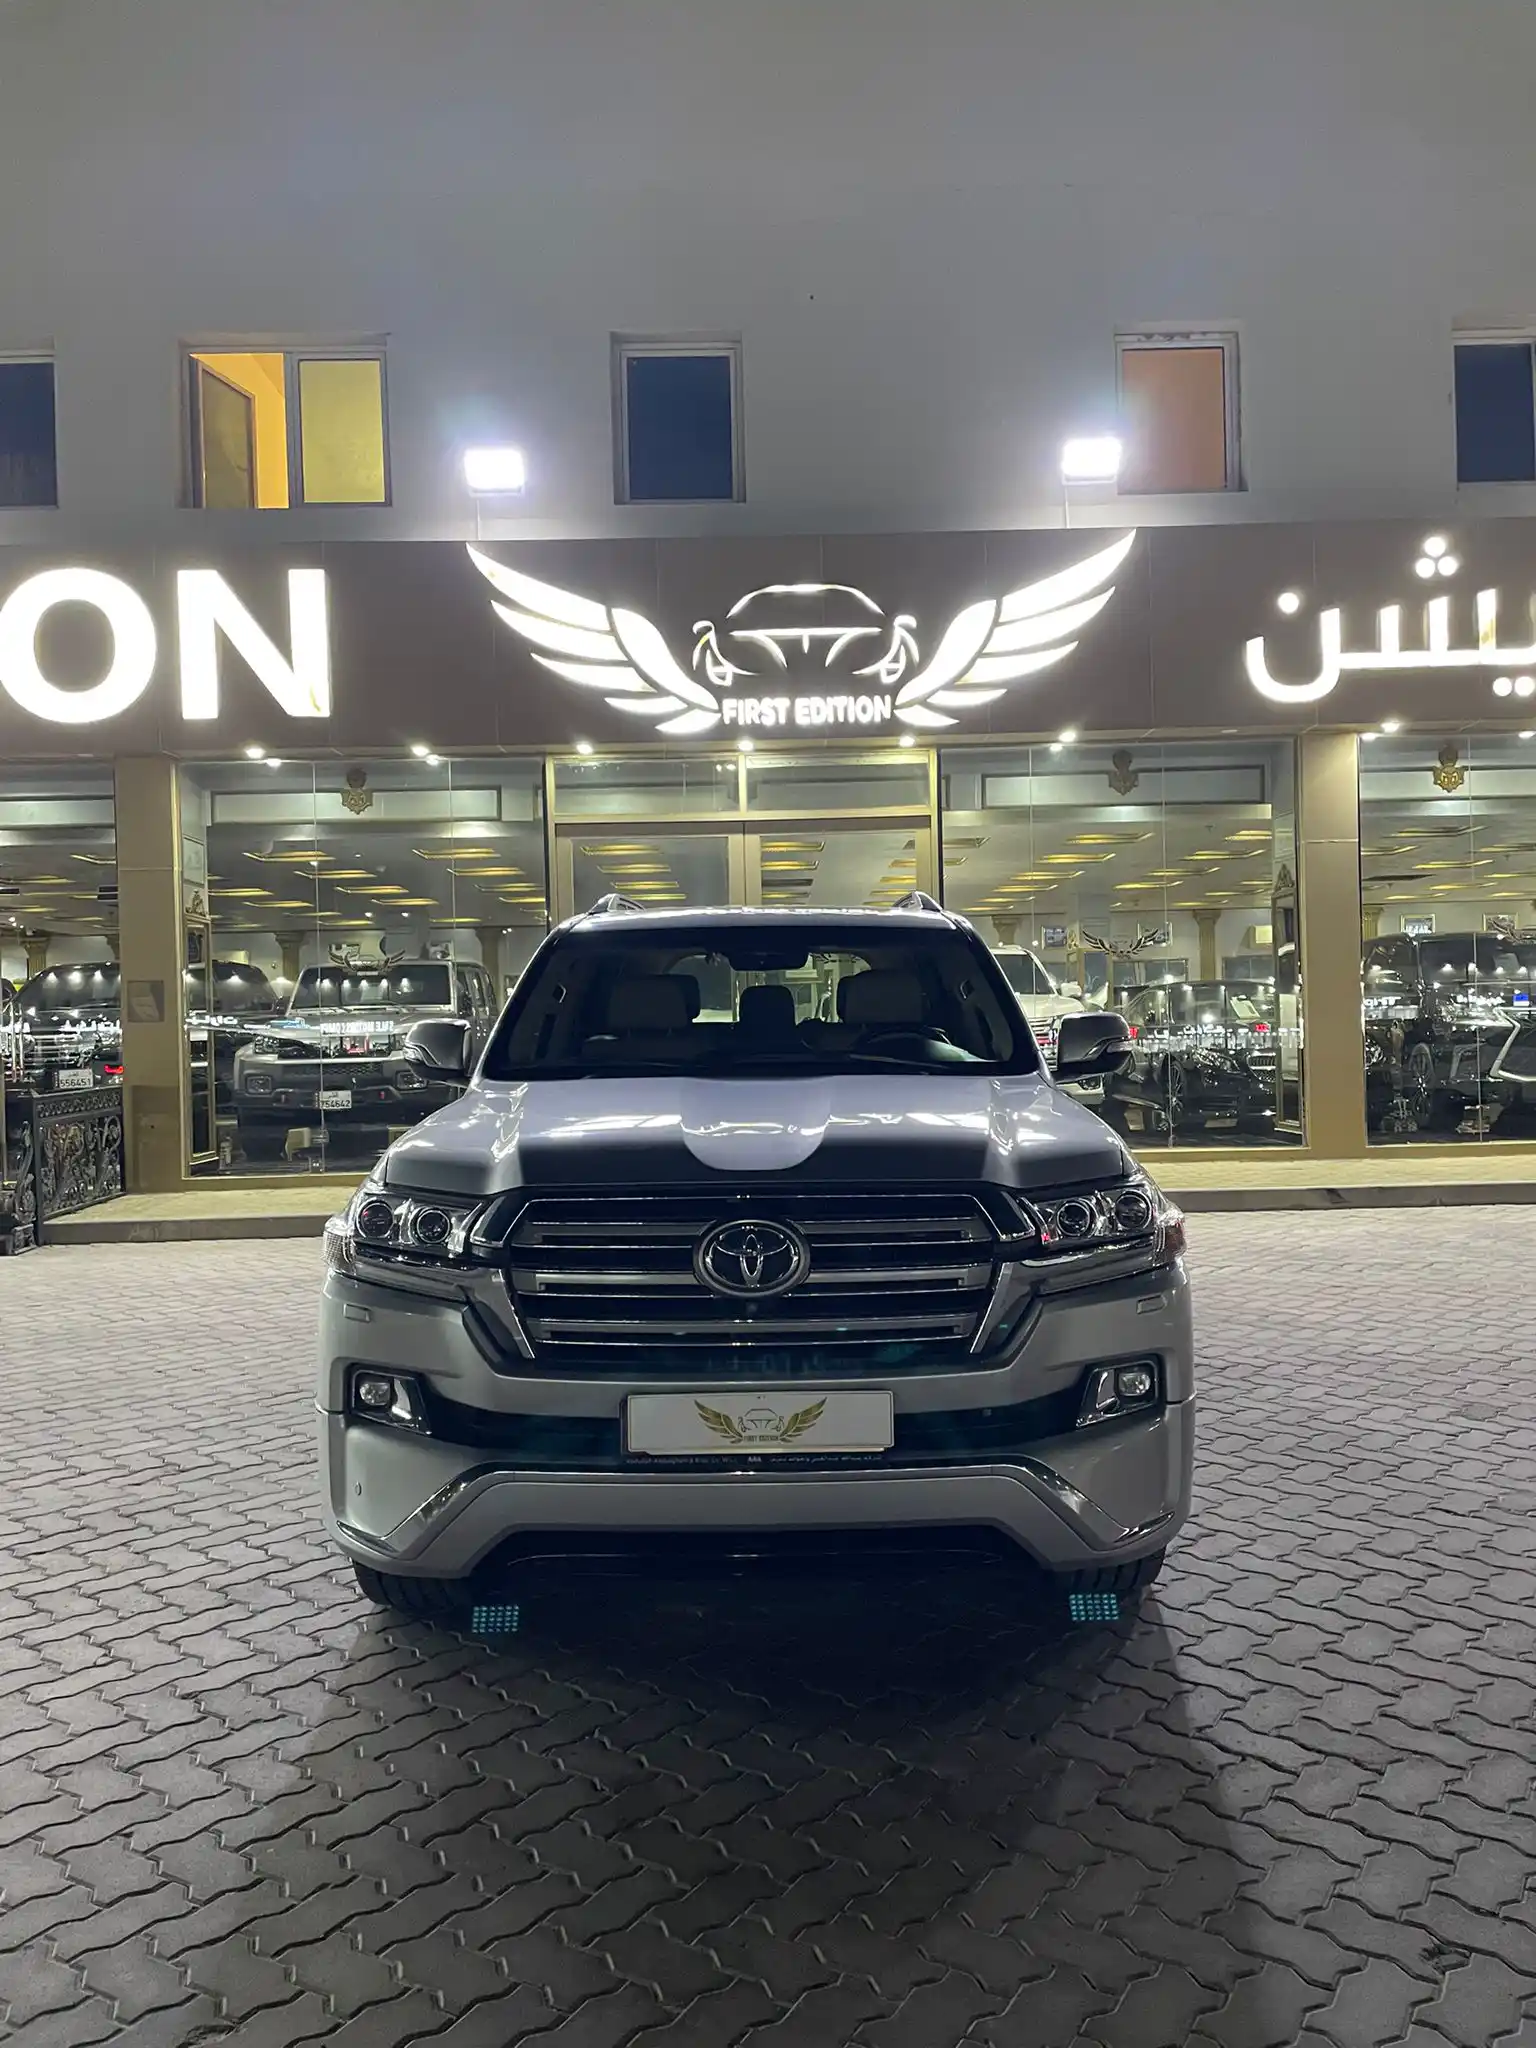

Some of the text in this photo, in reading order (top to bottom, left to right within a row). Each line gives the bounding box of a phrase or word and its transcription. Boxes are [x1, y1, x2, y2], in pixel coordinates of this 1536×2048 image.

[0, 567, 331, 723] ON
[722, 694, 892, 726] FIRST EDITION
